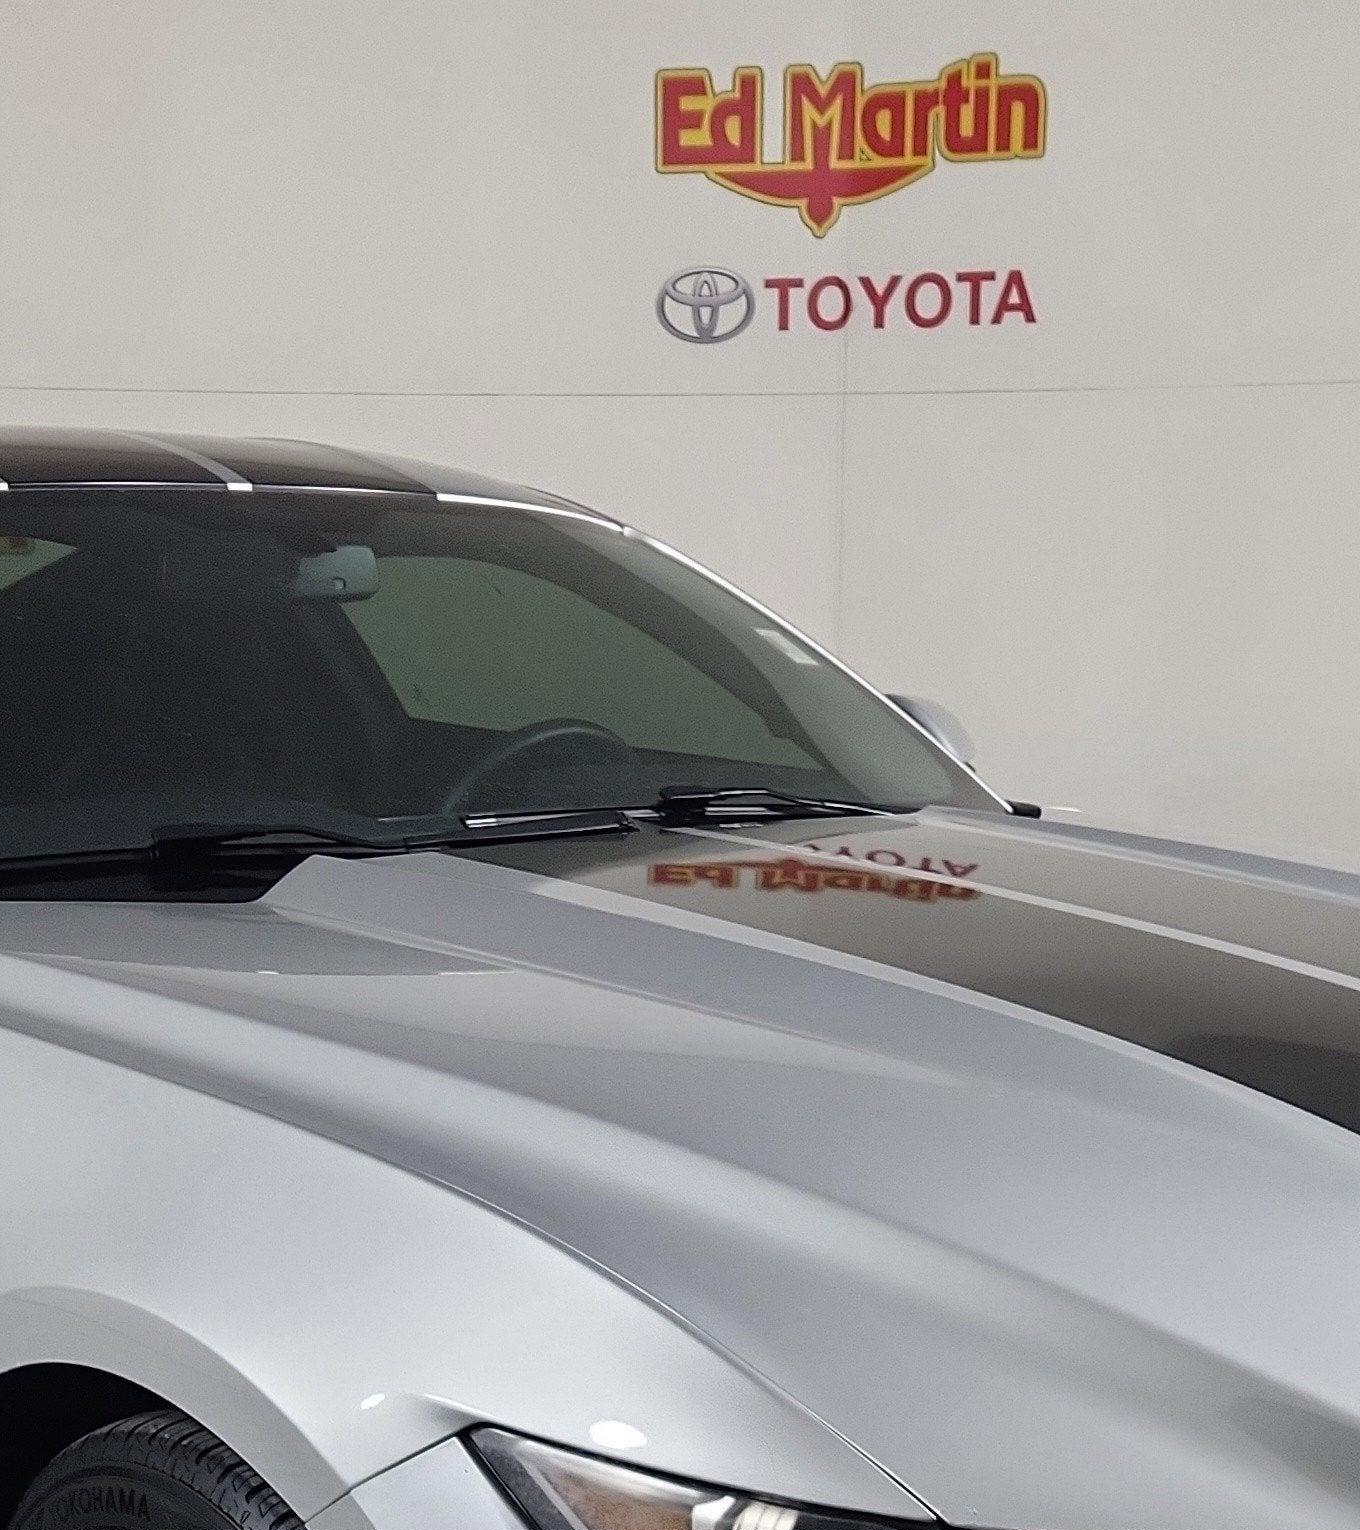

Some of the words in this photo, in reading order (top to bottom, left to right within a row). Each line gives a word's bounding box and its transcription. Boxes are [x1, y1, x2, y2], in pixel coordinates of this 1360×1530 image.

[655, 66, 763, 172] Ed
[785, 52, 1047, 168] Martin
[763, 269, 1037, 331] TOYOTA
